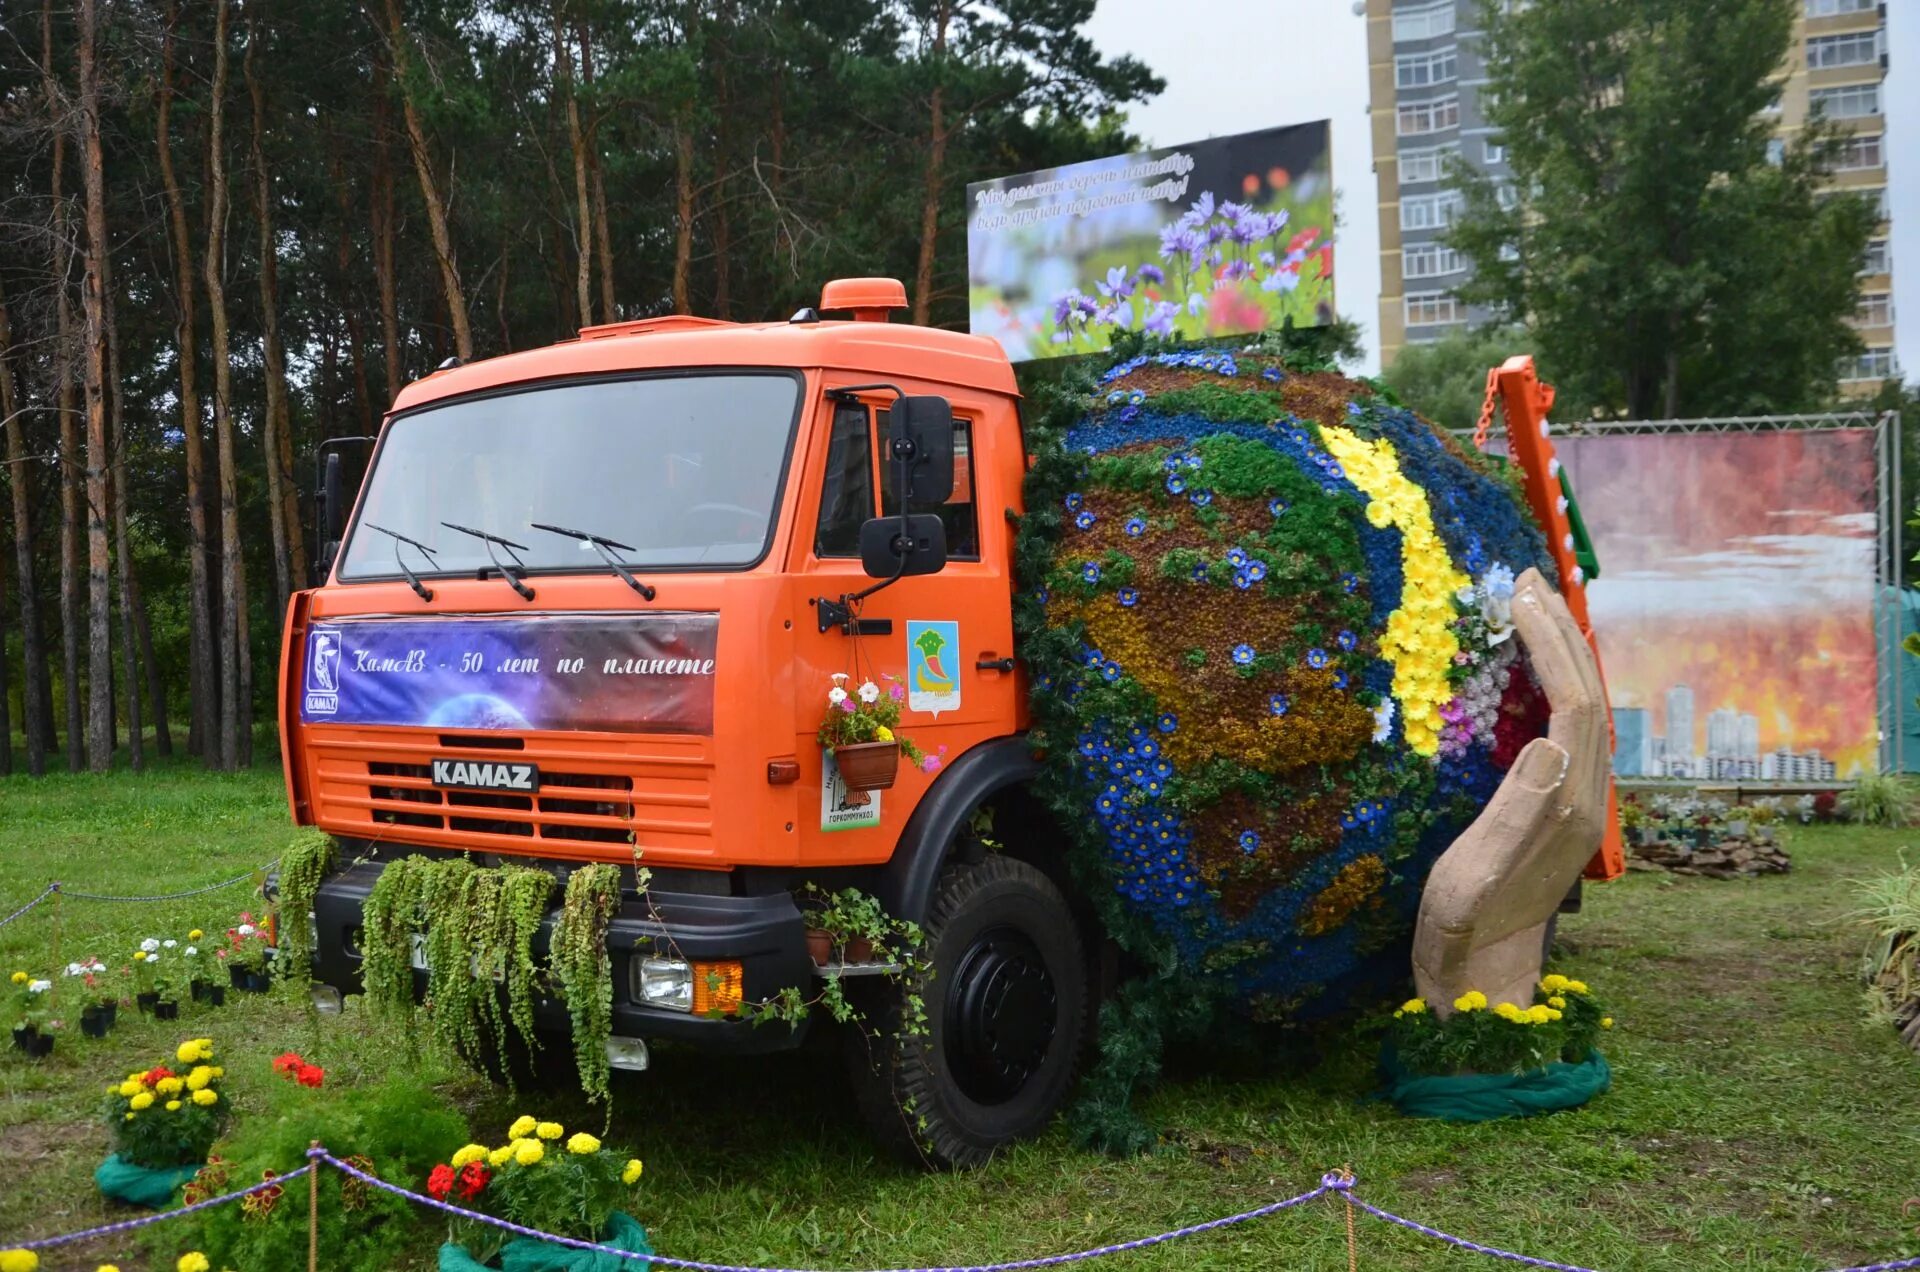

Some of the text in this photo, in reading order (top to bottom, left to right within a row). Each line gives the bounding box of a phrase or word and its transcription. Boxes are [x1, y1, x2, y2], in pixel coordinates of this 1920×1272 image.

[975, 188, 1006, 208] Мы
[350, 649, 425, 673] КамАЗ
[459, 652, 483, 673] 50
[496, 655, 540, 673] лет
[556, 656, 585, 674] по
[603, 657, 715, 675] планете
[433, 761, 532, 789] KAMAZ
[829, 811, 873, 824] ГОРКОММУНХОЗ
